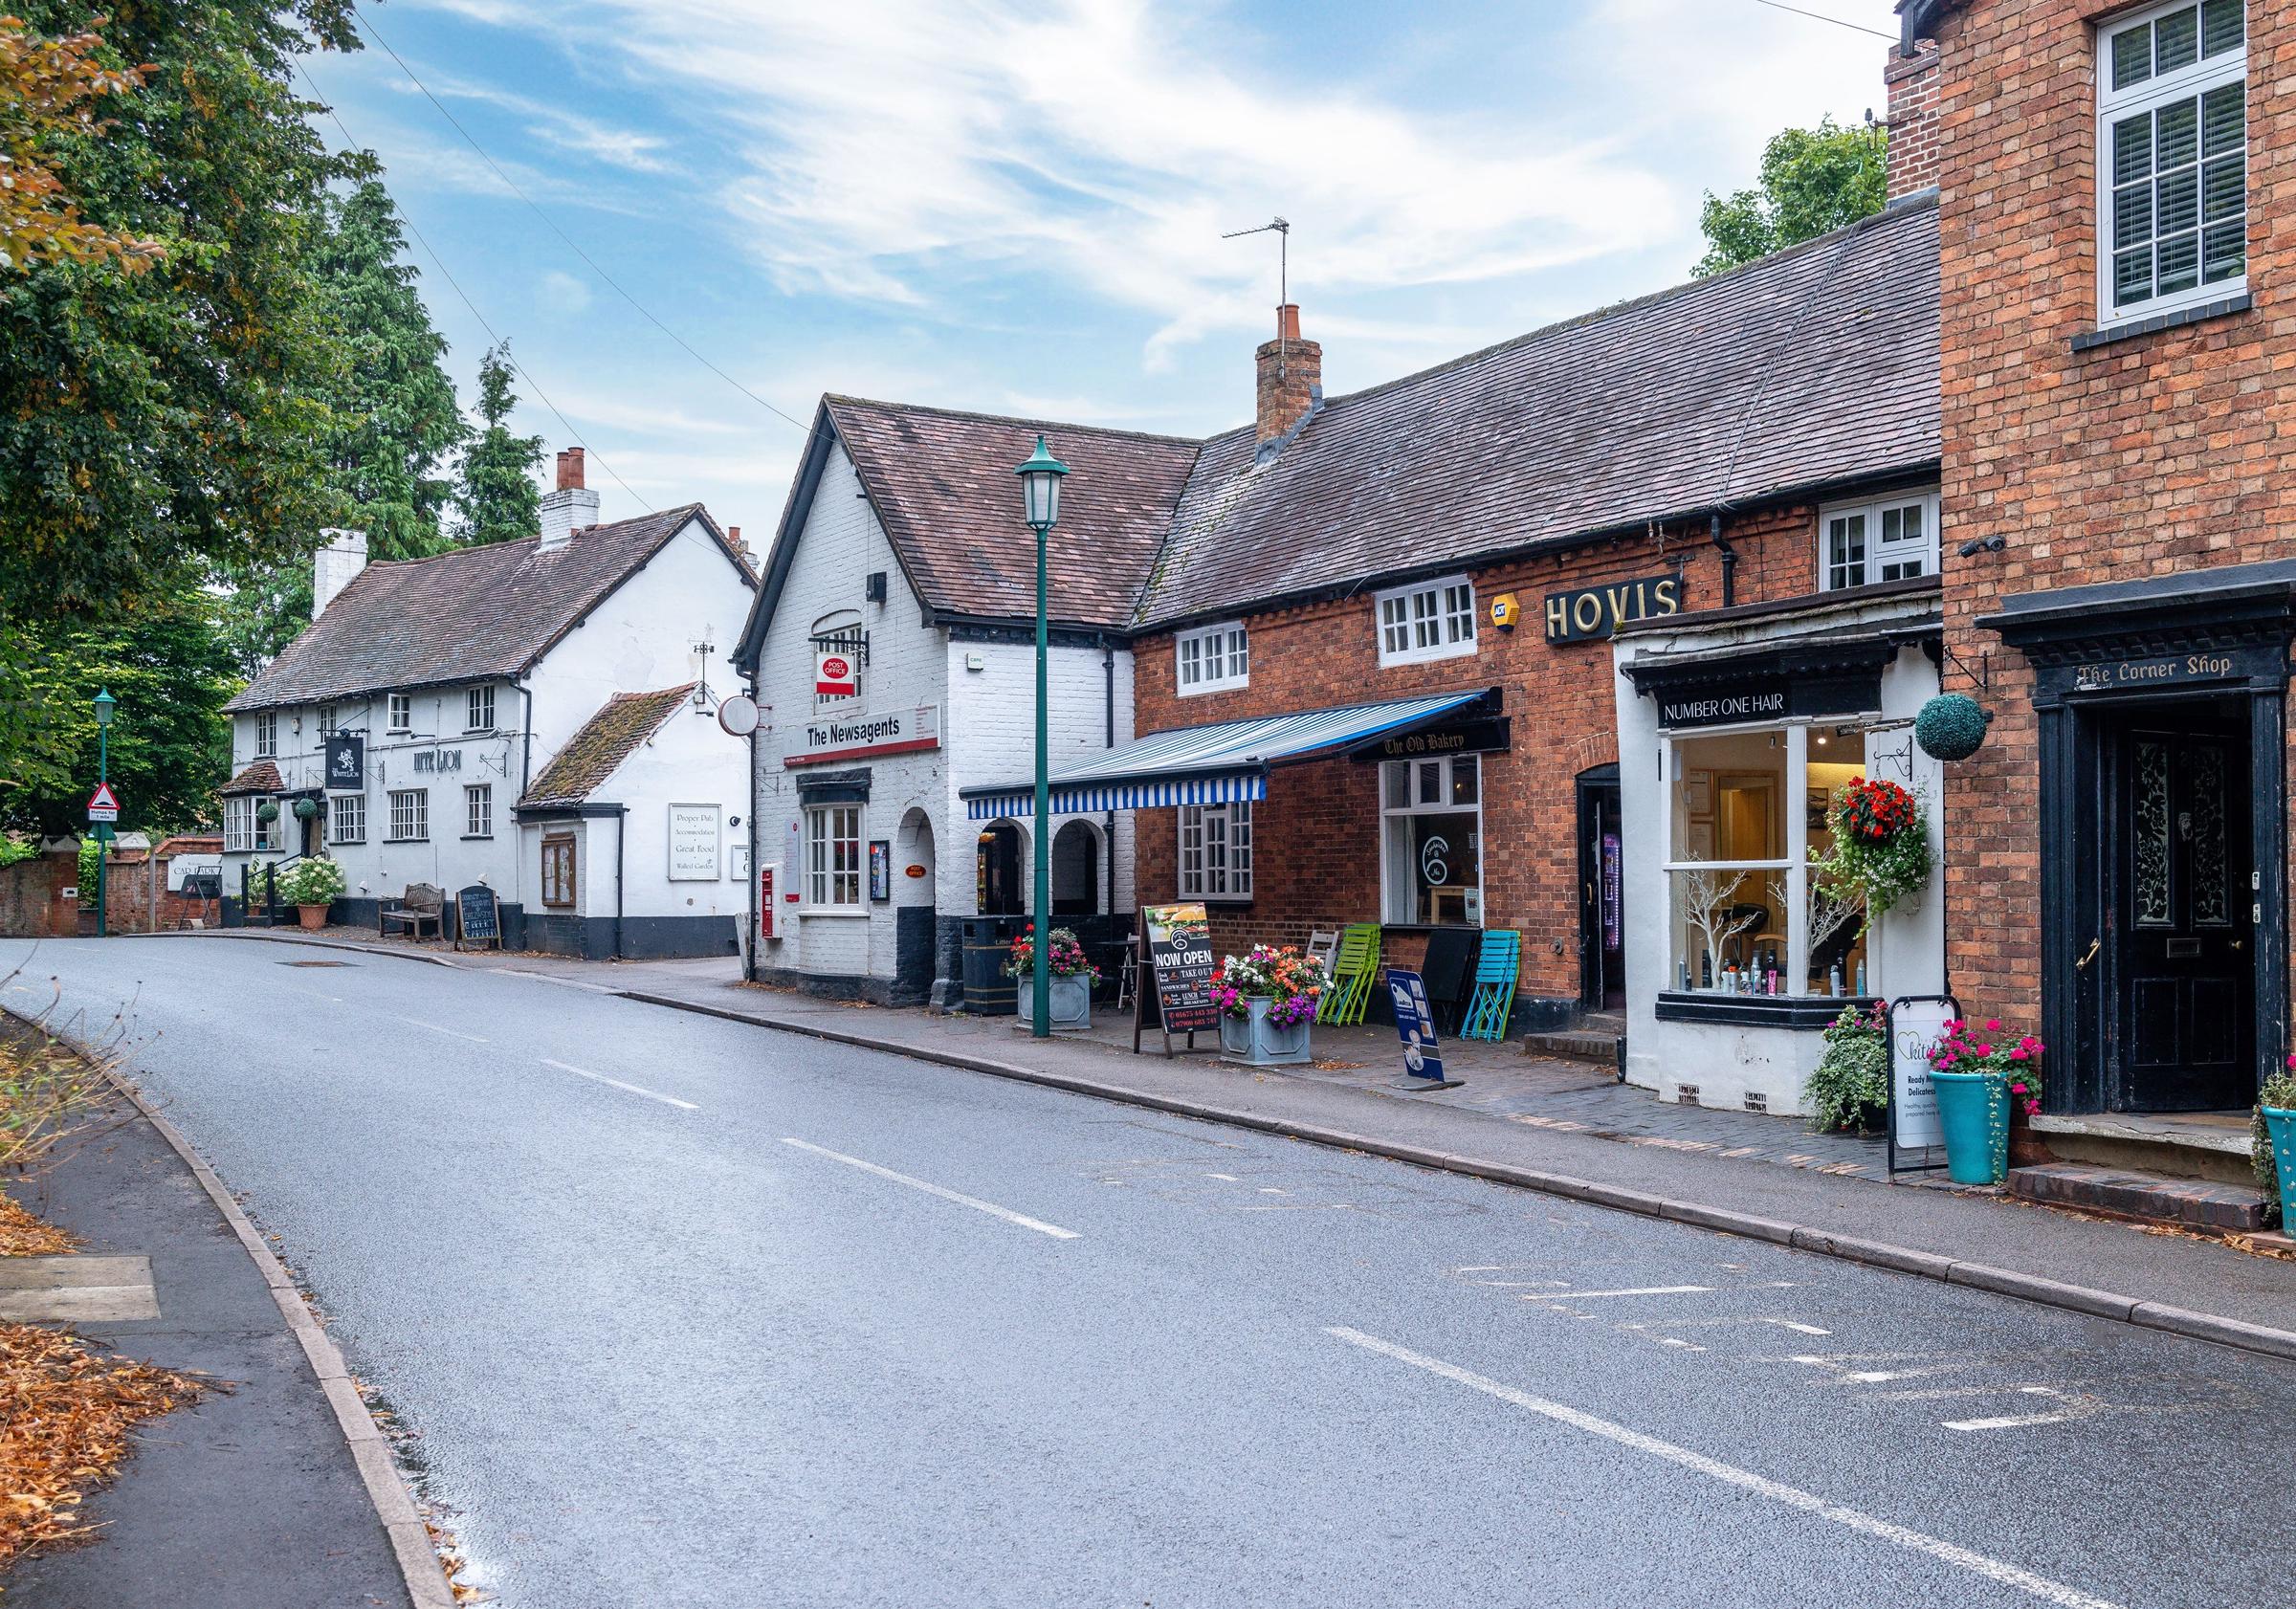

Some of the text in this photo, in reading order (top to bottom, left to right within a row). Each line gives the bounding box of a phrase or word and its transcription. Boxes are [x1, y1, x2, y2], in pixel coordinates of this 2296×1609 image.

[1494, 605, 1505, 615] ADT
[1546, 580, 1677, 638] HOVIS
[2078, 655, 2232, 684] The Corner Shop
[1665, 693, 1783, 720] NUMBER ONE HAIR
[807, 727, 828, 747] The
[829, 716, 899, 743] Newsagents
[1384, 733, 1465, 755] The Old Bakery
[436, 749, 461, 772] LION
[676, 814, 698, 823] Proper
[1155, 949, 1213, 967] NOW OPEN
[1181, 967, 1213, 979] TAKE OUT
[1908, 1075, 1925, 1086] Ready
[1908, 1088, 1936, 1096] Delicatess
